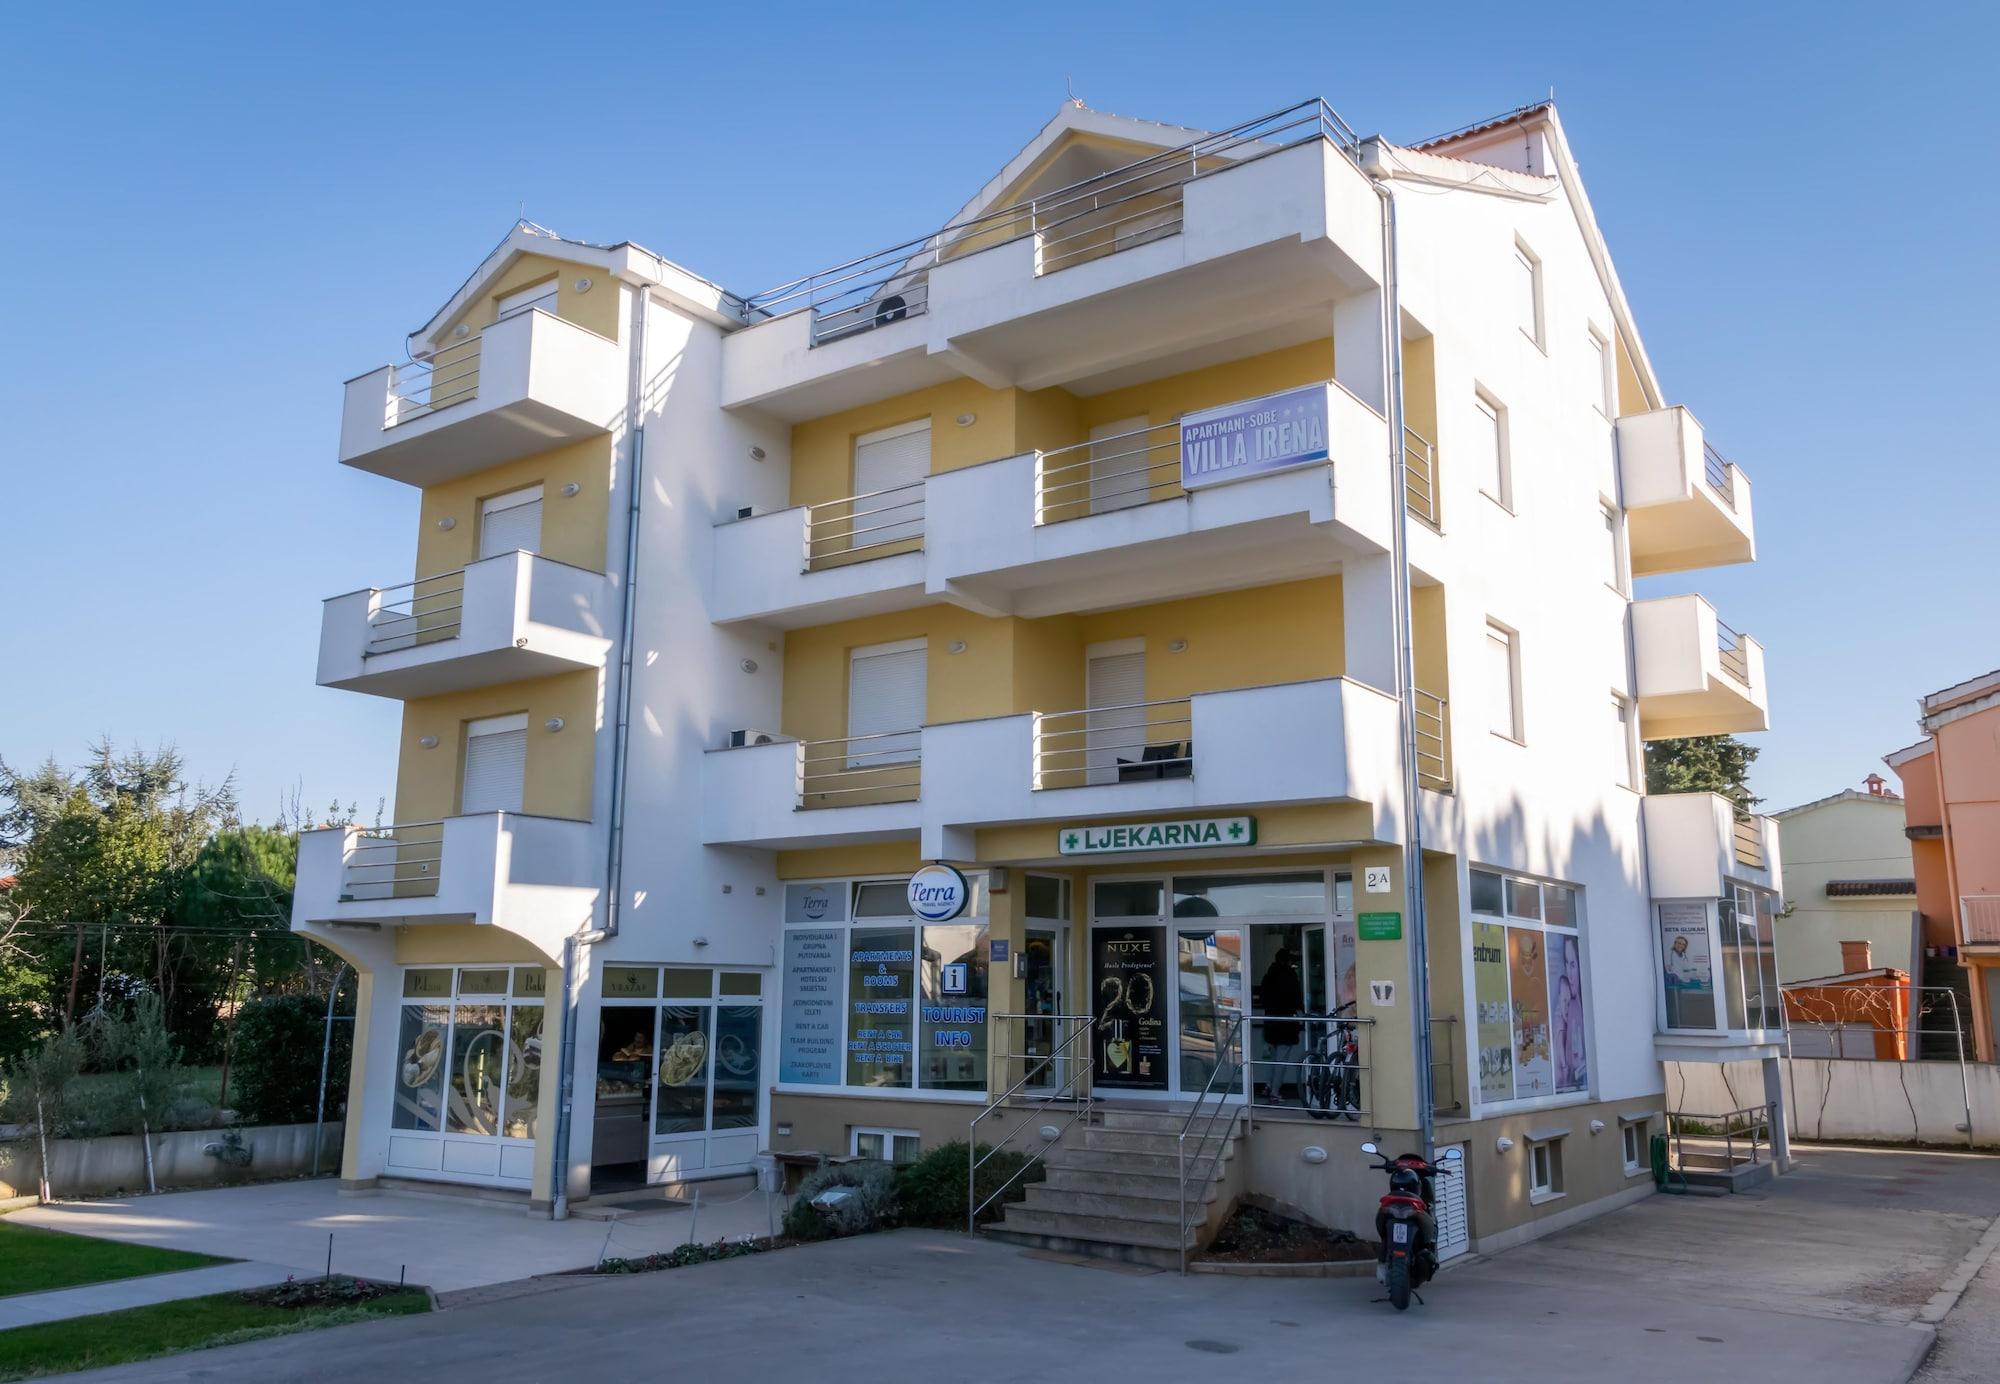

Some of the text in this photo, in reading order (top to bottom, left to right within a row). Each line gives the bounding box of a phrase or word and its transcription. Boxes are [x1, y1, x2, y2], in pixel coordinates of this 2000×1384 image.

[1185, 409, 1277, 442] APARTMANI-SOBE
[1187, 415, 1324, 475] VILLA IRENA
[1085, 822, 1221, 849] LJEKARNA
[912, 882, 955, 902] Terra
[802, 896, 829, 909] Terra
[1107, 943, 1151, 952] NUXE
[851, 950, 913, 962] APARTMENTS
[878, 963, 888, 975] &
[863, 975, 899, 987] ROOMS
[855, 1002, 908, 1014] TRANSFERS
[922, 1006, 986, 1023] TOURIST
[857, 1029, 903, 1040] RENT A CAR
[935, 1030, 972, 1047] INFO
[806, 1037, 835, 1045] BUILDING
[855, 1053, 874, 1063] RENT
[885, 1054, 904, 1064] BIKE
